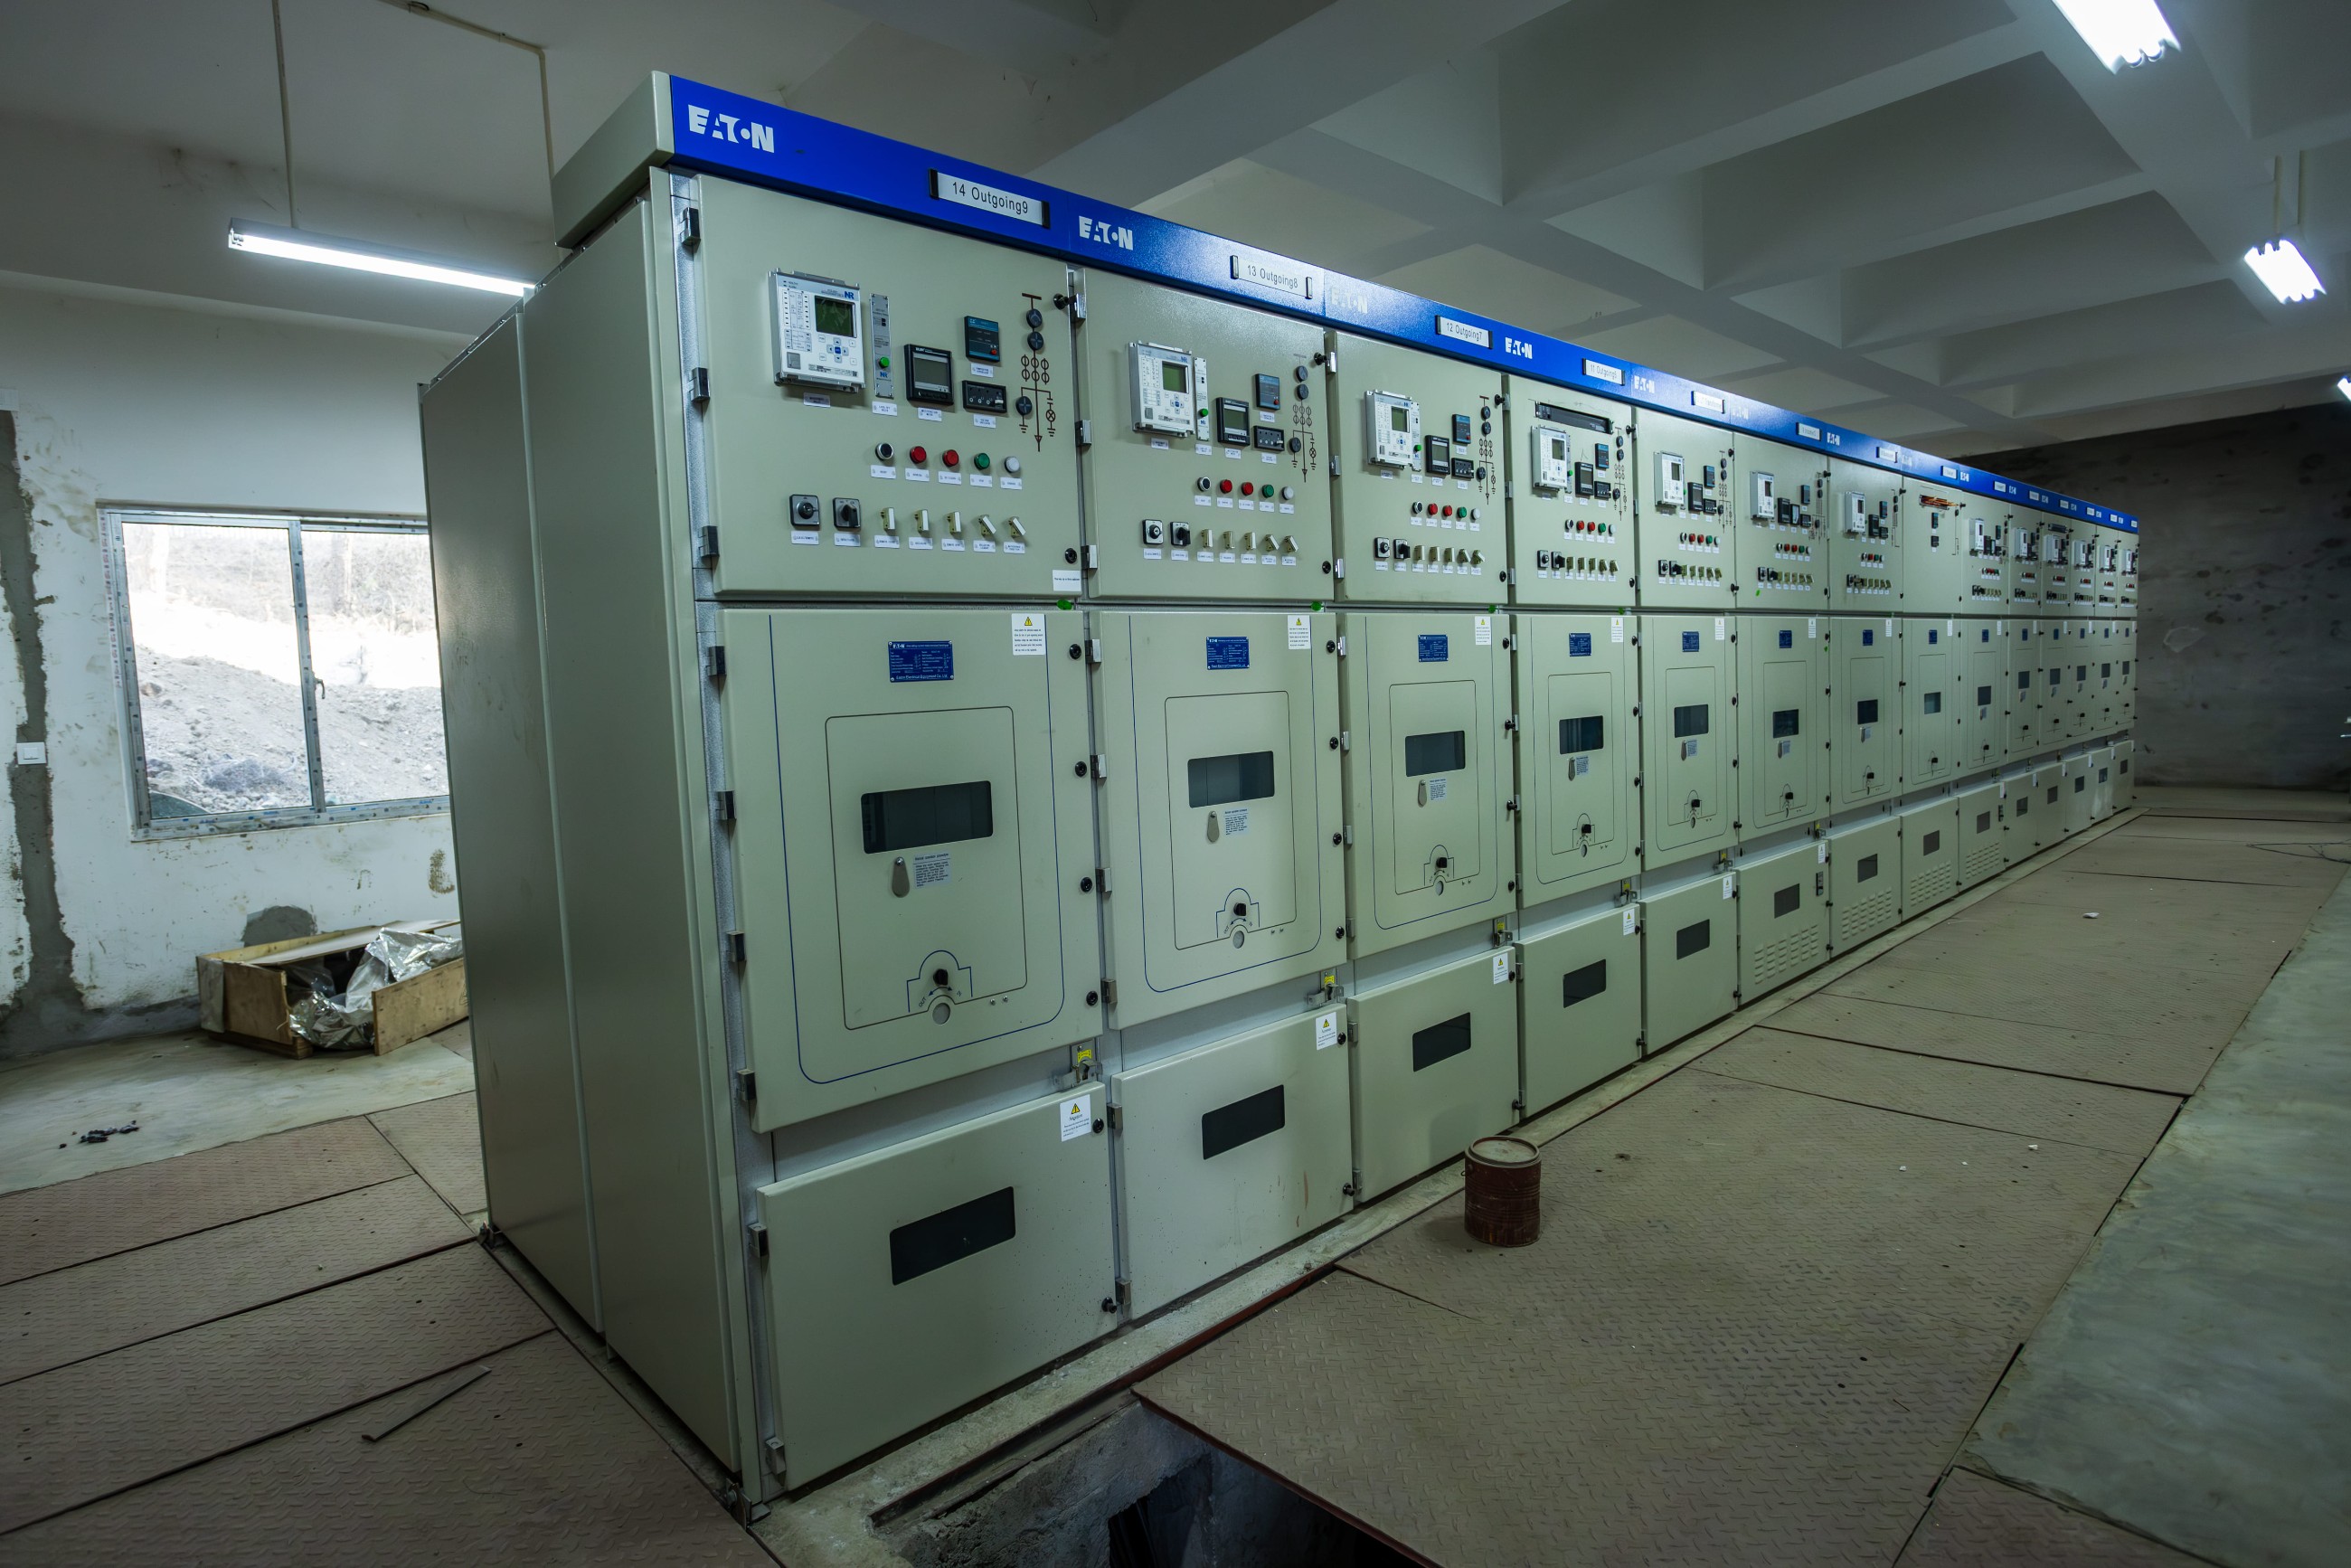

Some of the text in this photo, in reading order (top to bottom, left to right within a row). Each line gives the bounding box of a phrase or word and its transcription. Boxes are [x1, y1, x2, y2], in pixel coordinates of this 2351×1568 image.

[688, 104, 775, 154] EATON
[952, 181, 1028, 215] 14 Outgoing9
[1079, 215, 1134, 250] EATON
[1247, 264, 1298, 289] 13 Outgoing8
[844, 290, 854, 300] NR
[1446, 322, 1483, 342] 12 Outgoing7
[1505, 336, 1533, 360] EATON
[1634, 375, 1656, 394] EATON
